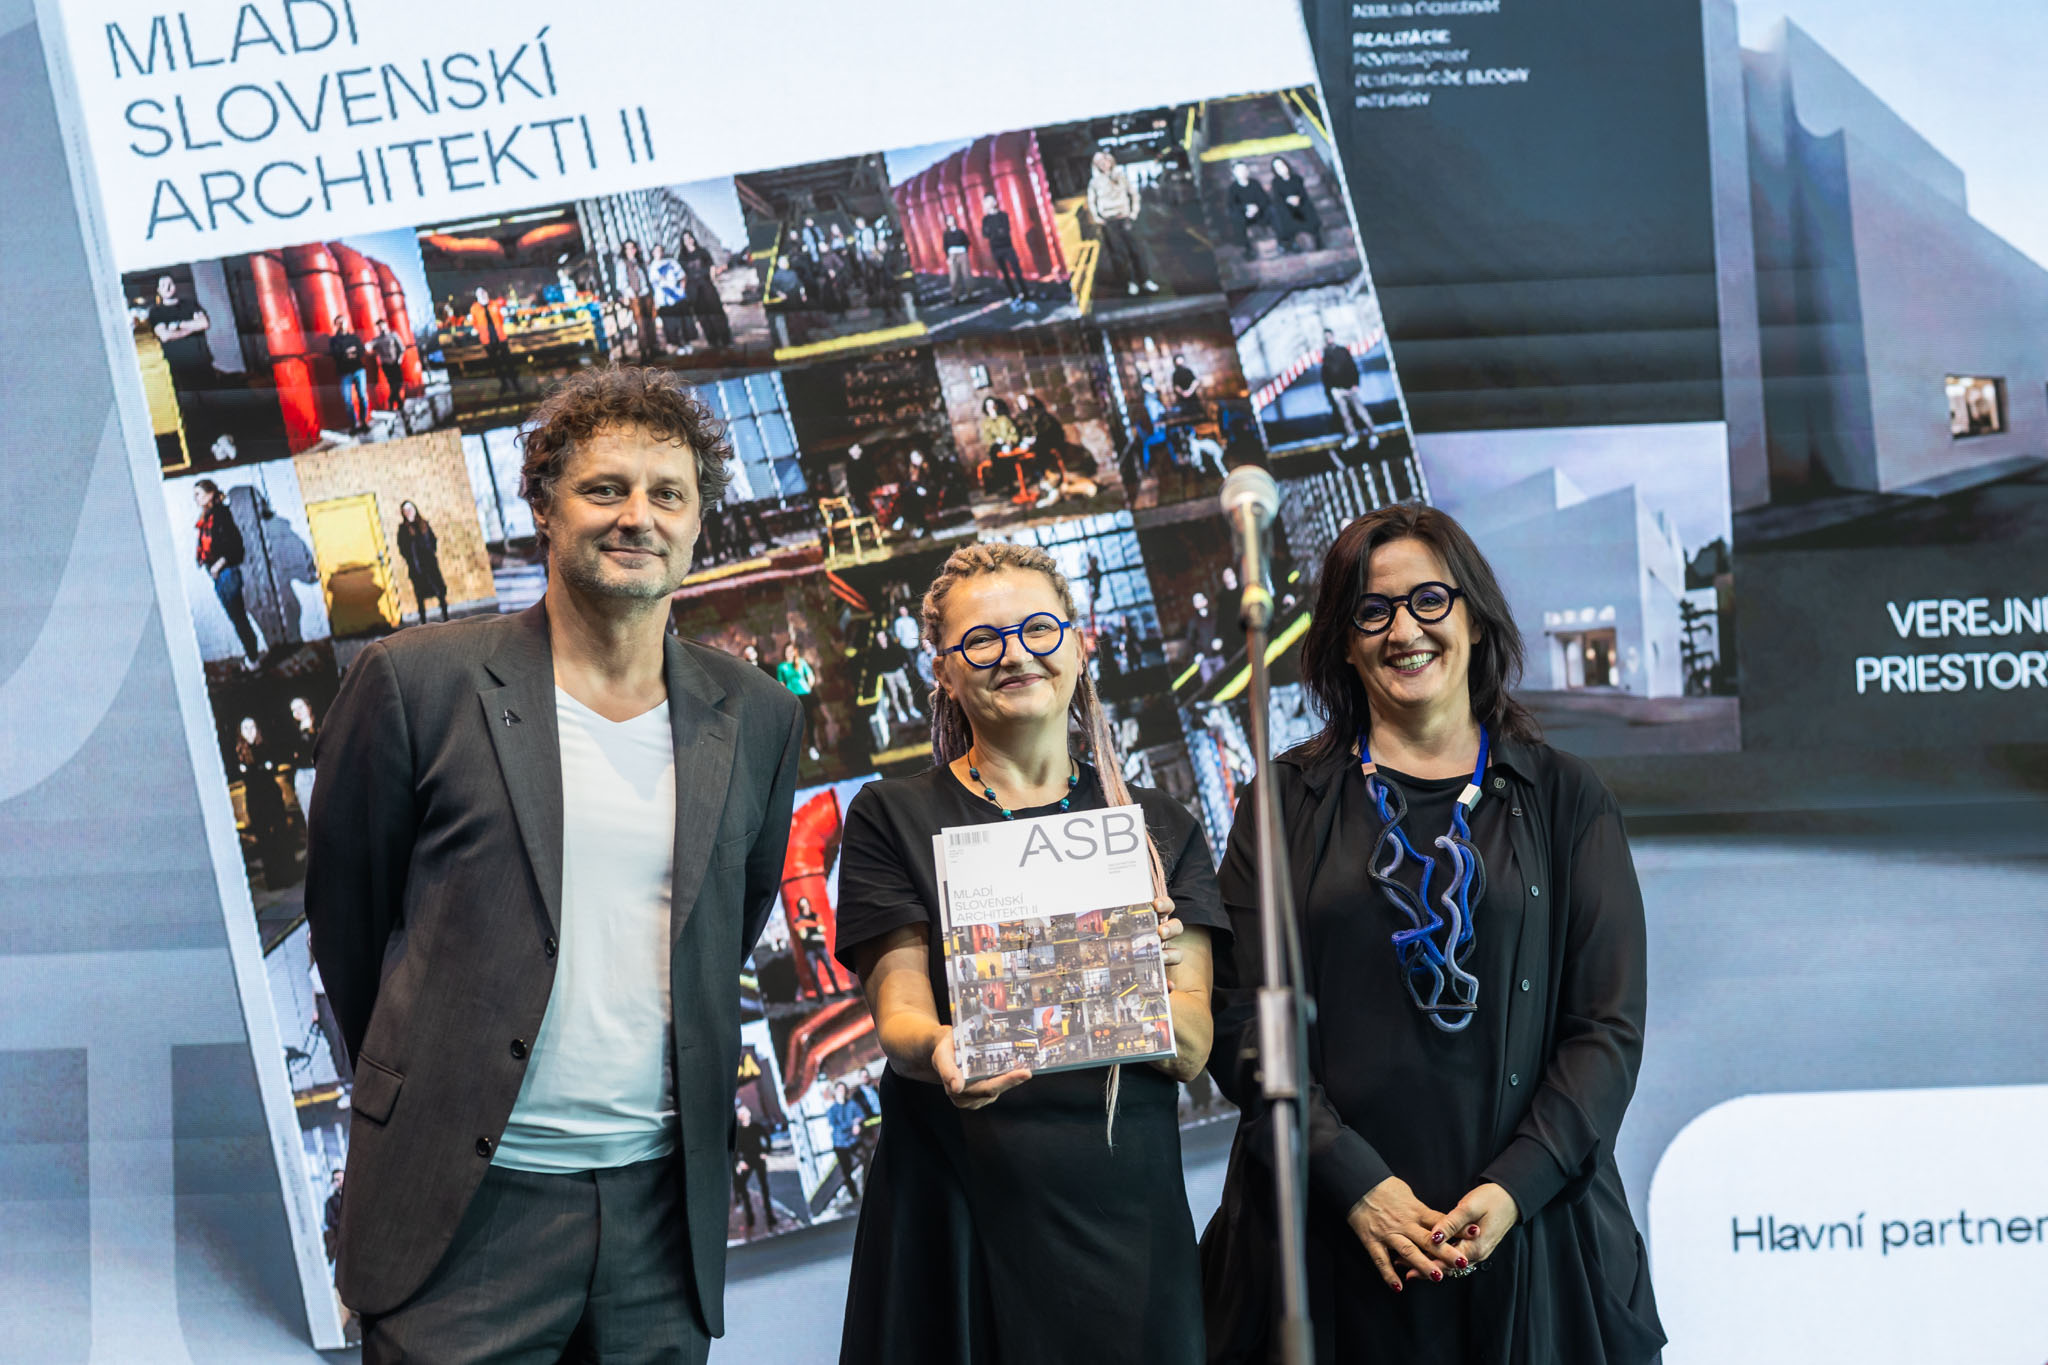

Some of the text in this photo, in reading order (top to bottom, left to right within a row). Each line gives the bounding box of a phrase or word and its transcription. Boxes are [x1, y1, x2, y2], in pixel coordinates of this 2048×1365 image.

[124, 25, 558, 158] SLOVENSKÍ
[145, 114, 599, 241] ARCHITEKTI
[619, 106, 656, 164] II
[1855, 651, 2048, 694] PRIESTOR
[1018, 812, 1139, 868] ASB
[956, 906, 1029, 922] ARCHITEKTI
[1732, 1210, 2048, 1256] Hlavní partner
